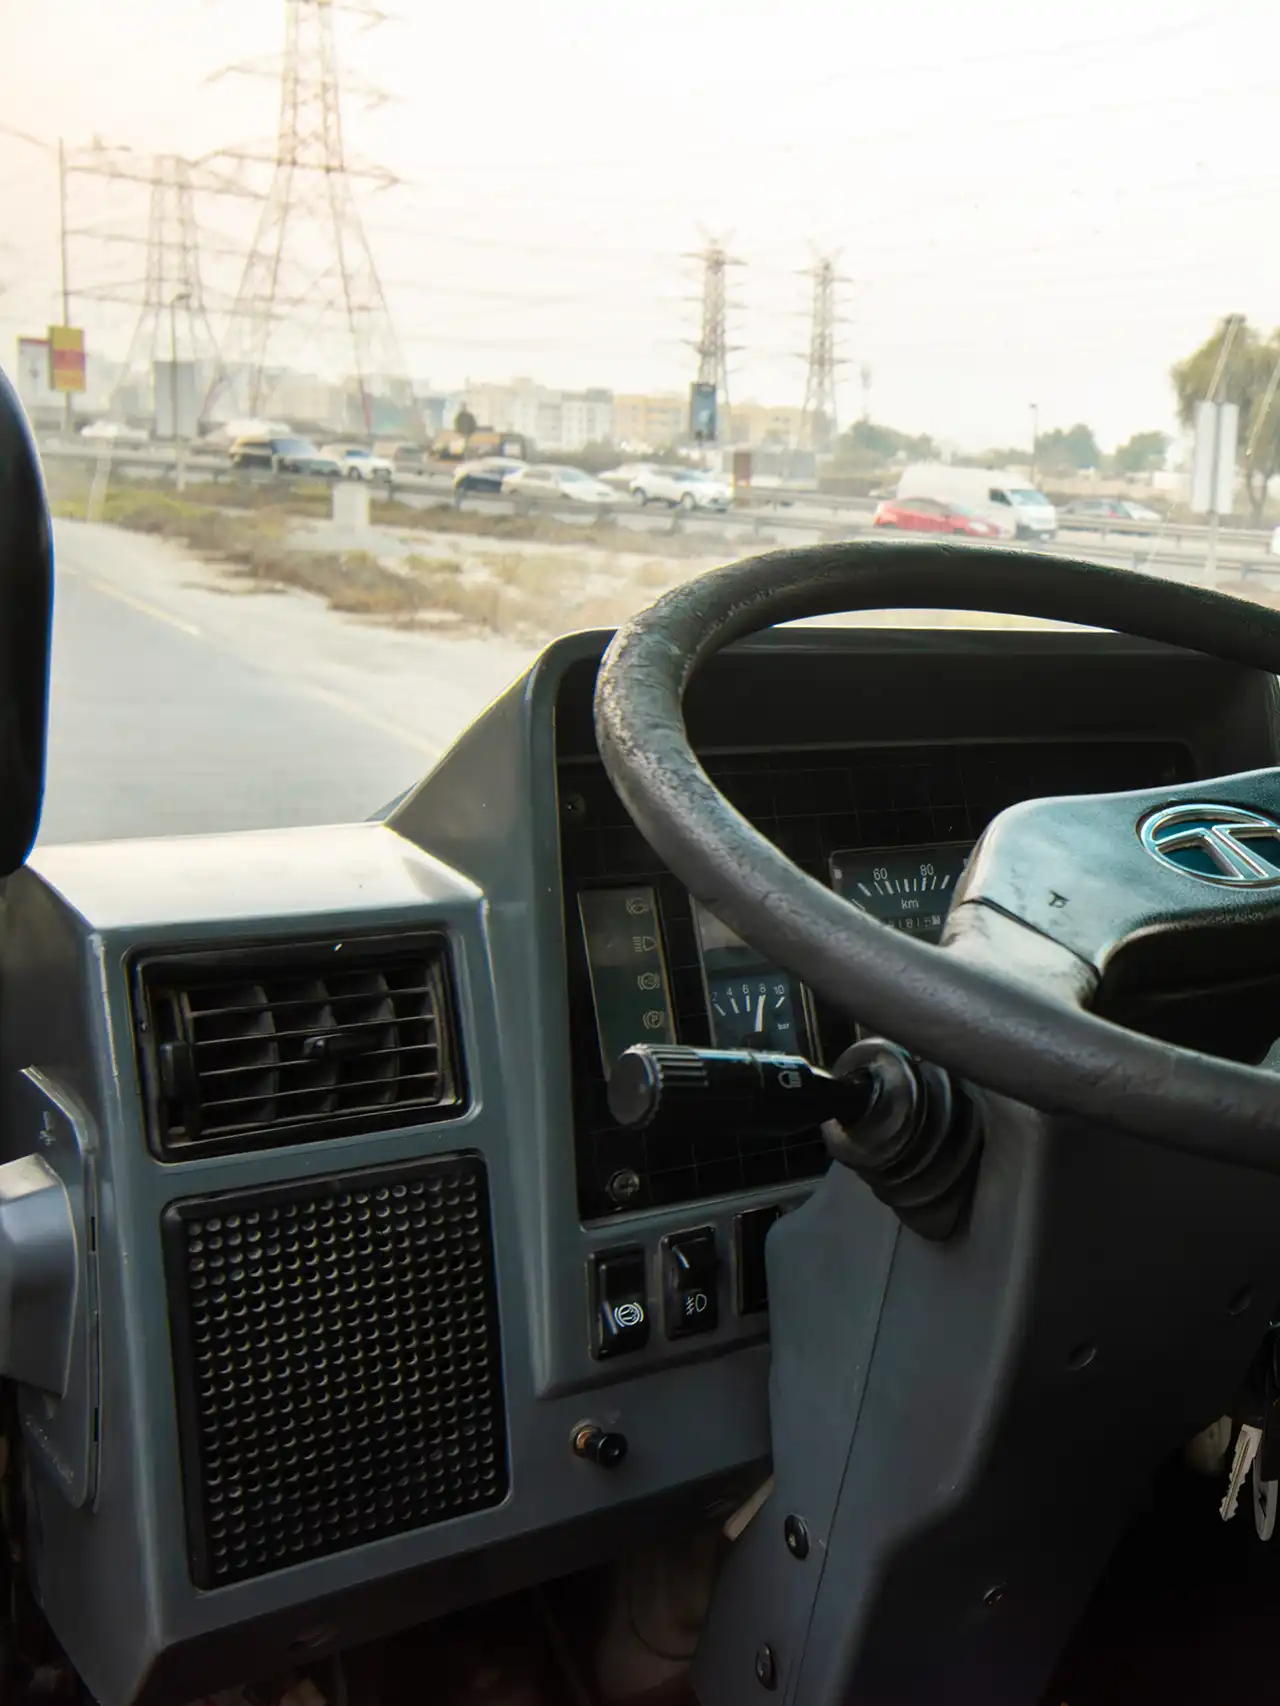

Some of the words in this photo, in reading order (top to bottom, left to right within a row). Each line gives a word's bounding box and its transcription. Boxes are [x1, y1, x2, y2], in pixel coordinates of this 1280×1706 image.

[873, 868, 888, 880] 60
[920, 863, 934, 876] 80
[901, 897, 919, 909] km
[726, 987, 733, 997] 4
[742, 984, 749, 994] 6
[759, 983, 767, 994] 8
[774, 984, 785, 995] 10
[778, 1022, 790, 1030] bar
